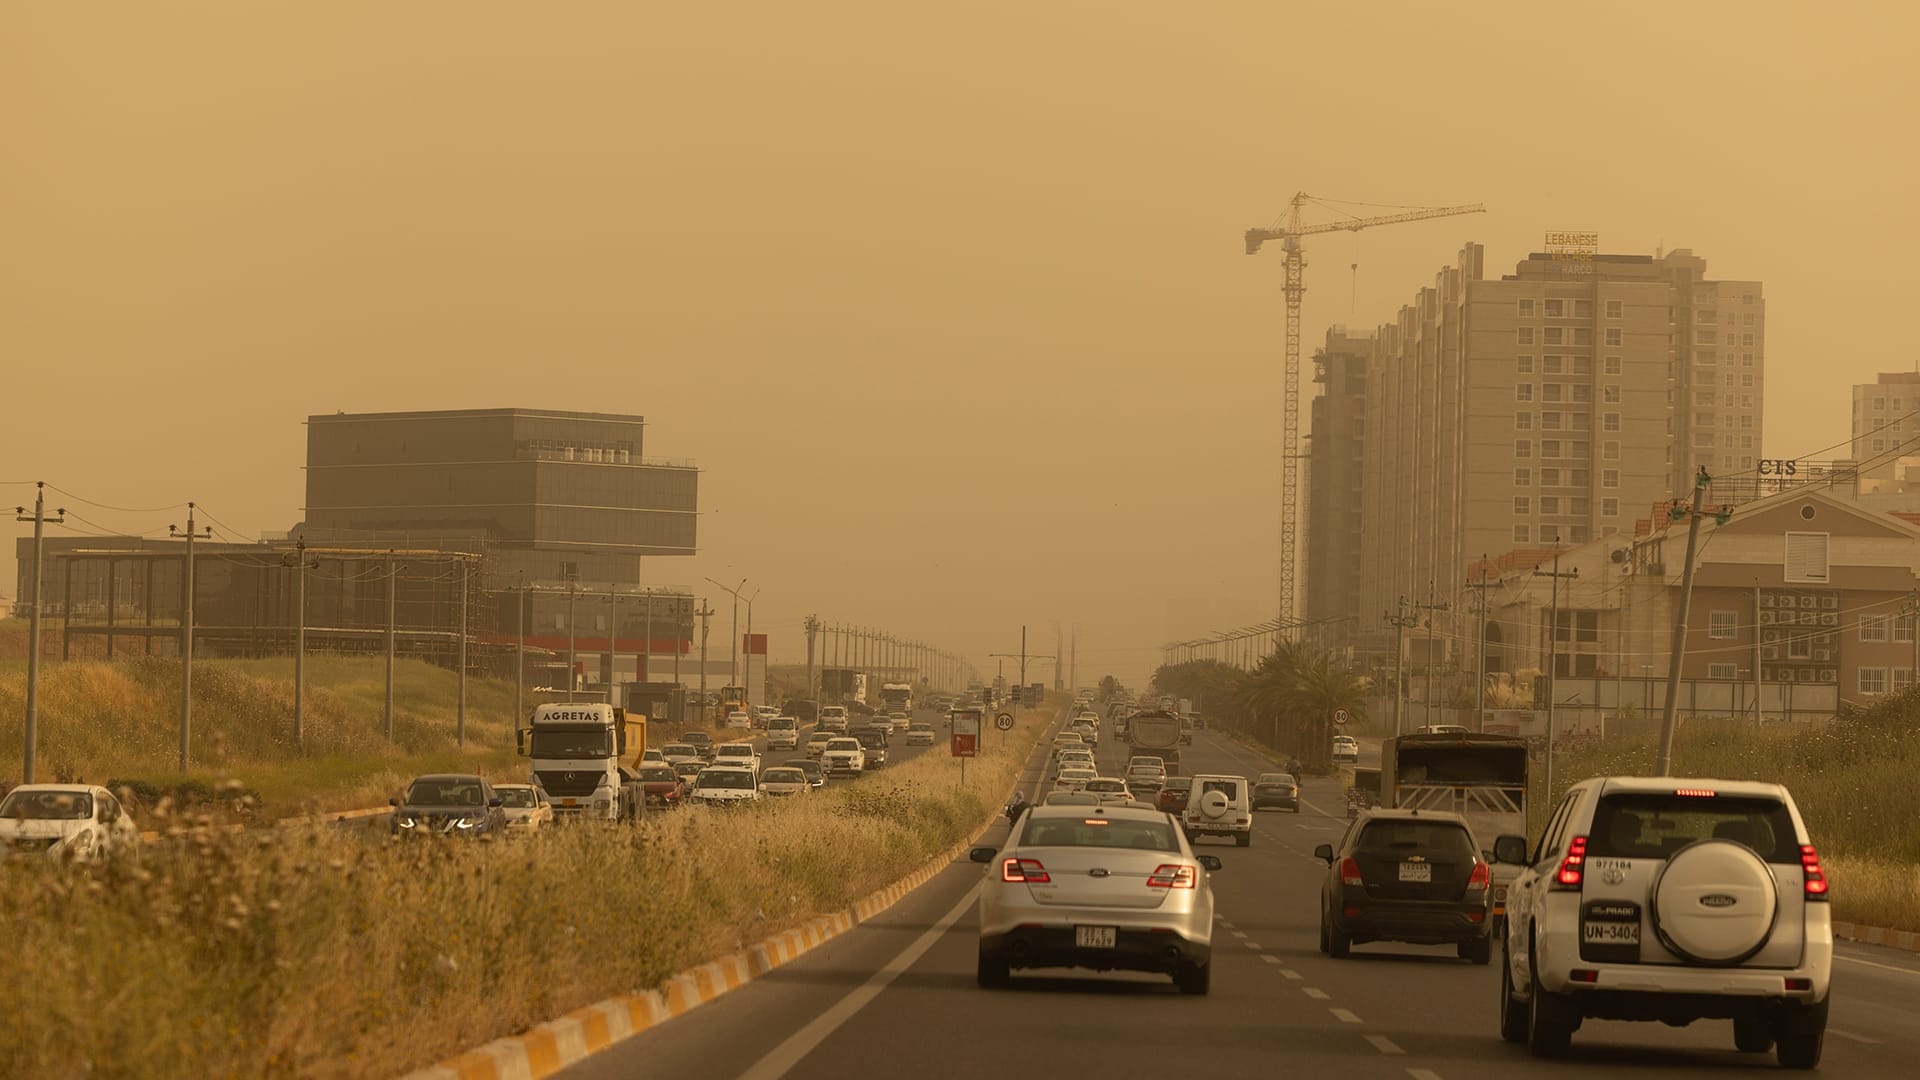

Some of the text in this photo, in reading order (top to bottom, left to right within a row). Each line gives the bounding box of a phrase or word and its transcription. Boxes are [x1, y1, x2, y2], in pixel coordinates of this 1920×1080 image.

[1545, 233, 1598, 246] LEBANESE
[1551, 248, 1592, 262] VILLAGE
[1759, 459, 1796, 475] CIS
[999, 717, 1011, 727] 80
[1336, 711, 1347, 721] 80
[1586, 925, 1638, 940] UN-3404
